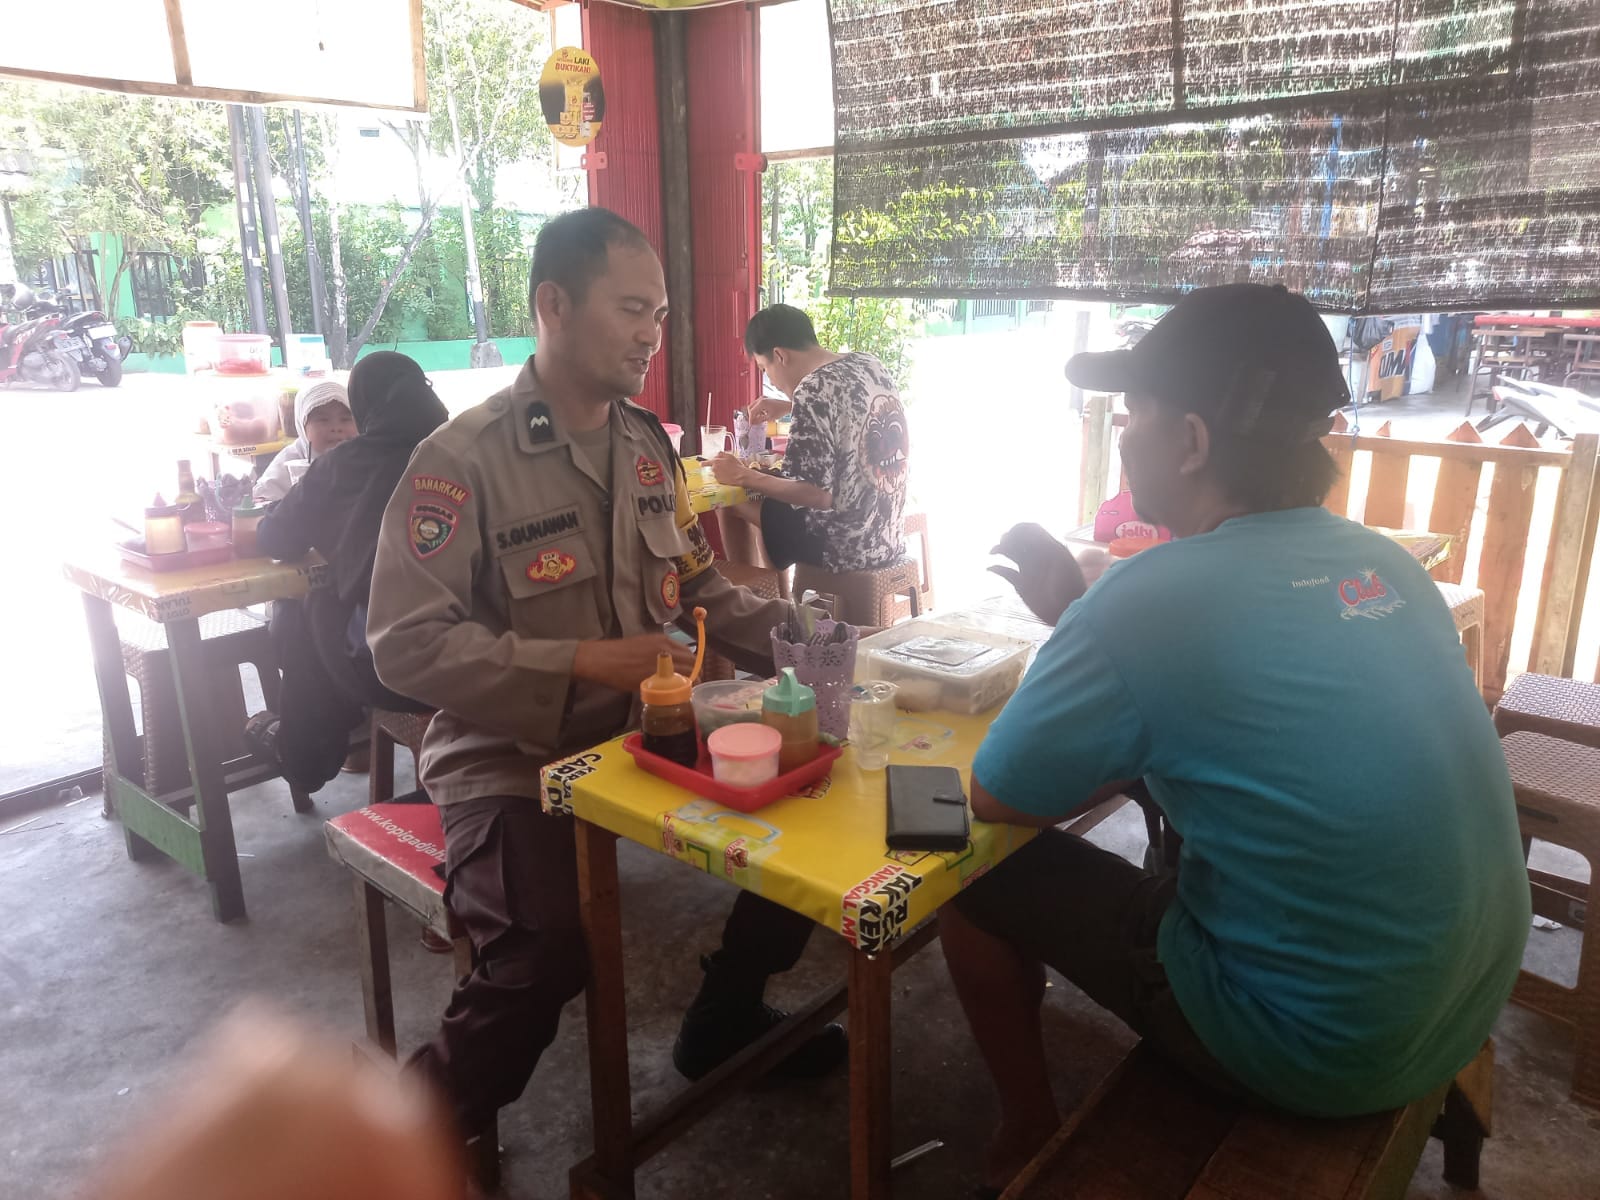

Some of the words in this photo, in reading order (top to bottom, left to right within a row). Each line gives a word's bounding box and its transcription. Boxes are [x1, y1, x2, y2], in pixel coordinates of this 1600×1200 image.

[574, 57, 590, 65] LAKI
[414, 478, 466, 502] BAHARKAM
[1338, 572, 1387, 608] Club
[549, 753, 602, 782] CARI
[562, 766, 597, 799] KERJA
[842, 863, 903, 911] TANGGAL
